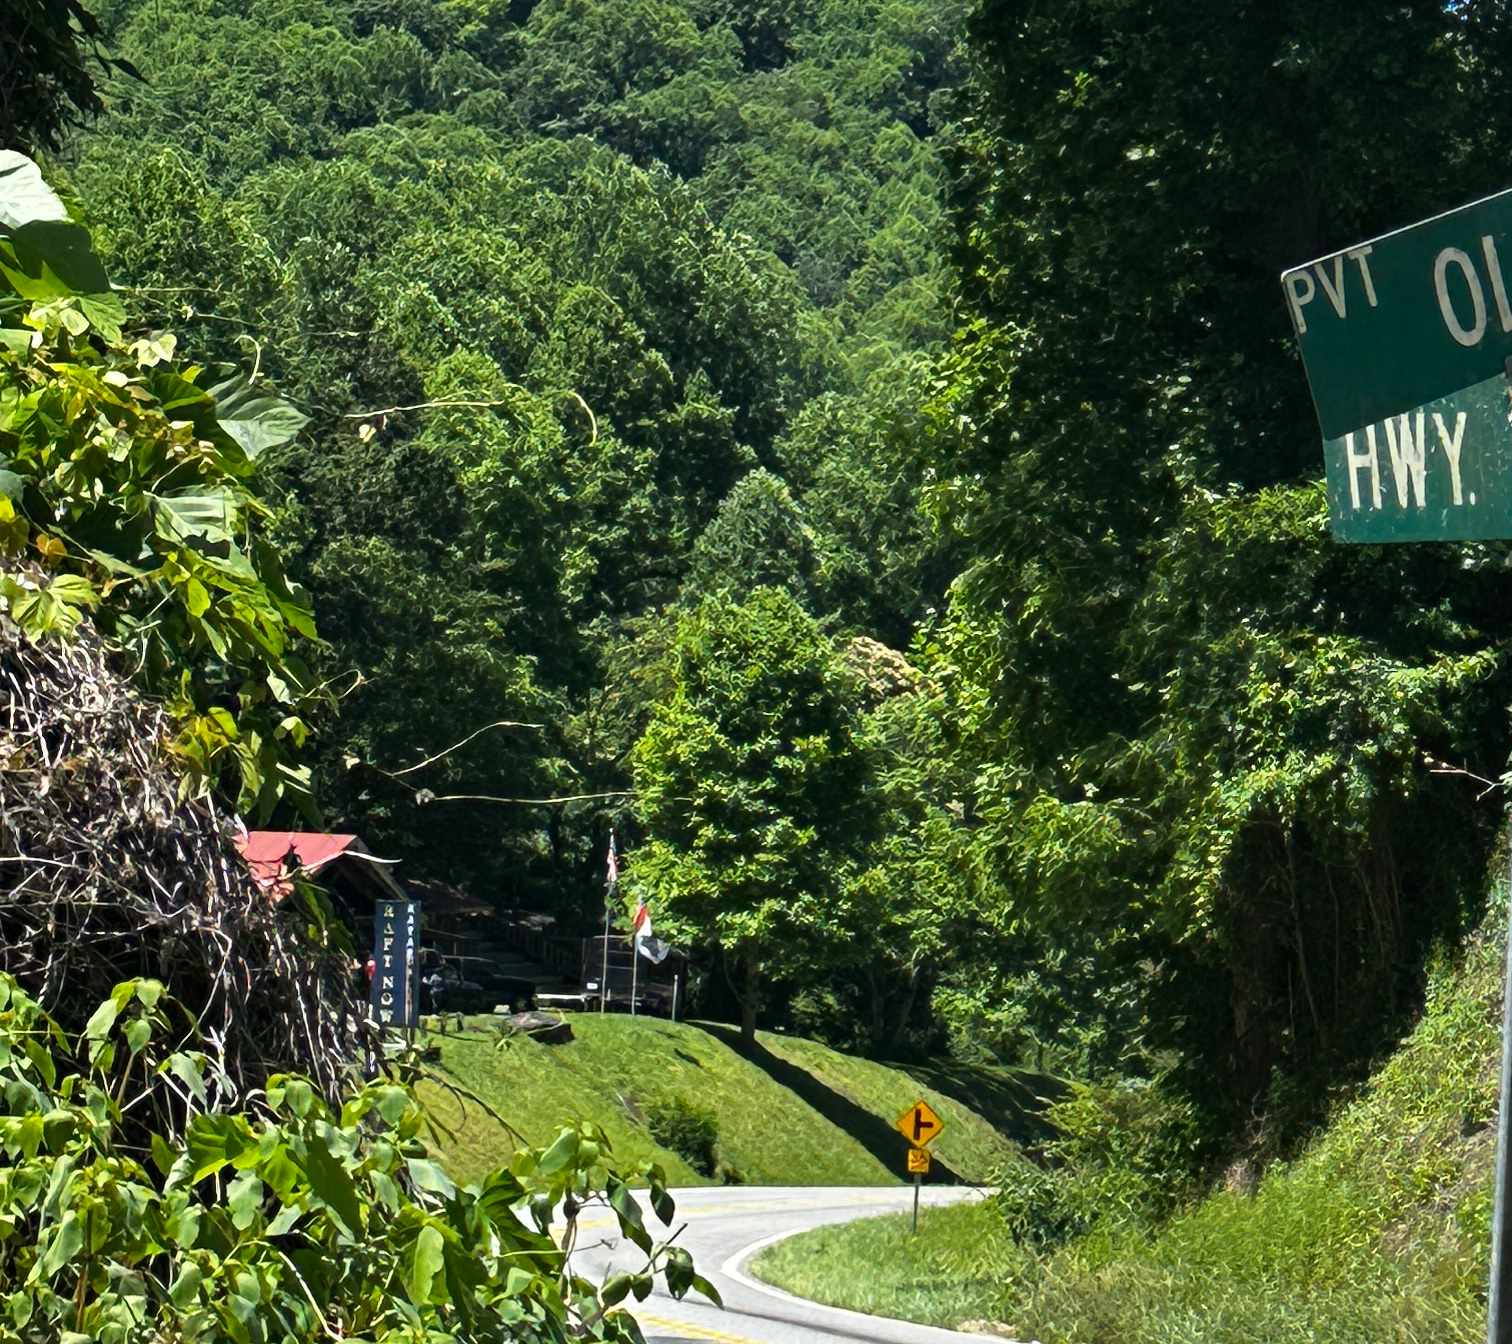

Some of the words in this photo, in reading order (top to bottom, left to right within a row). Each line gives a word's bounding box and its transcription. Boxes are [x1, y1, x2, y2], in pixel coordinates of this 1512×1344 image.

[1285, 245, 1378, 334] PVT
[1345, 411, 1476, 510] HWY.
[383, 904, 395, 966] RAFT
[380, 975, 394, 1023] NOW
